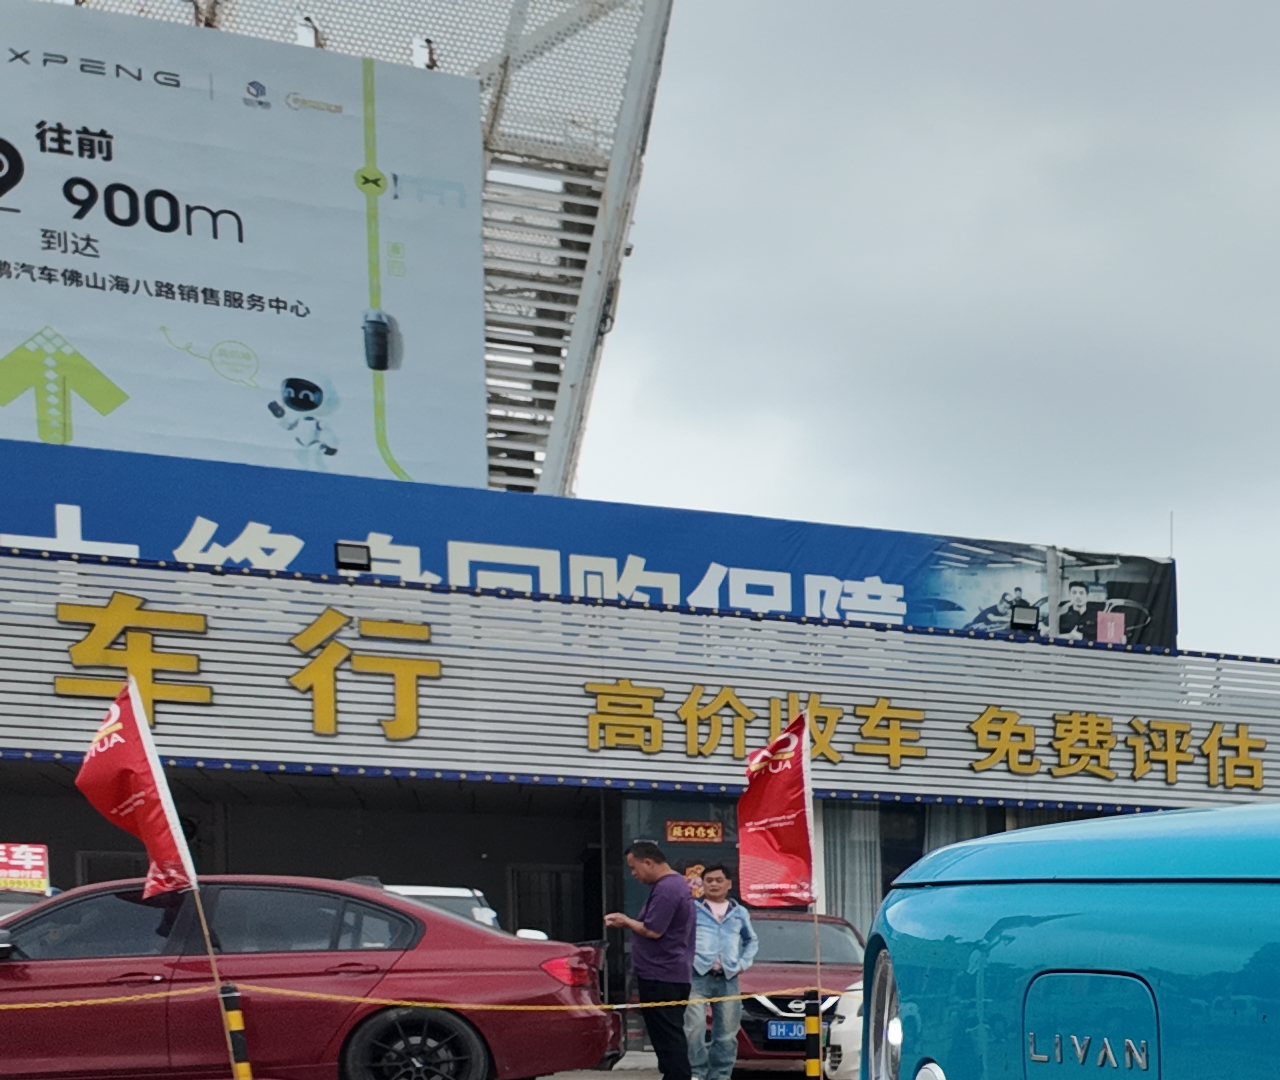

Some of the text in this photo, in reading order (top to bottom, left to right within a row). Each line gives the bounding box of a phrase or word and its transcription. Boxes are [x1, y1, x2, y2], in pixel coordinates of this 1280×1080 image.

[8, 48, 181, 88] XPENG
[35, 120, 114, 162] 往前
[62, 176, 244, 243] 900m
[40, 228, 100, 258] 到达
[54, 592, 442, 742] 车行
[969, 705, 1268, 791] 免费评估
[1027, 1031, 1149, 1070] LIVAN
